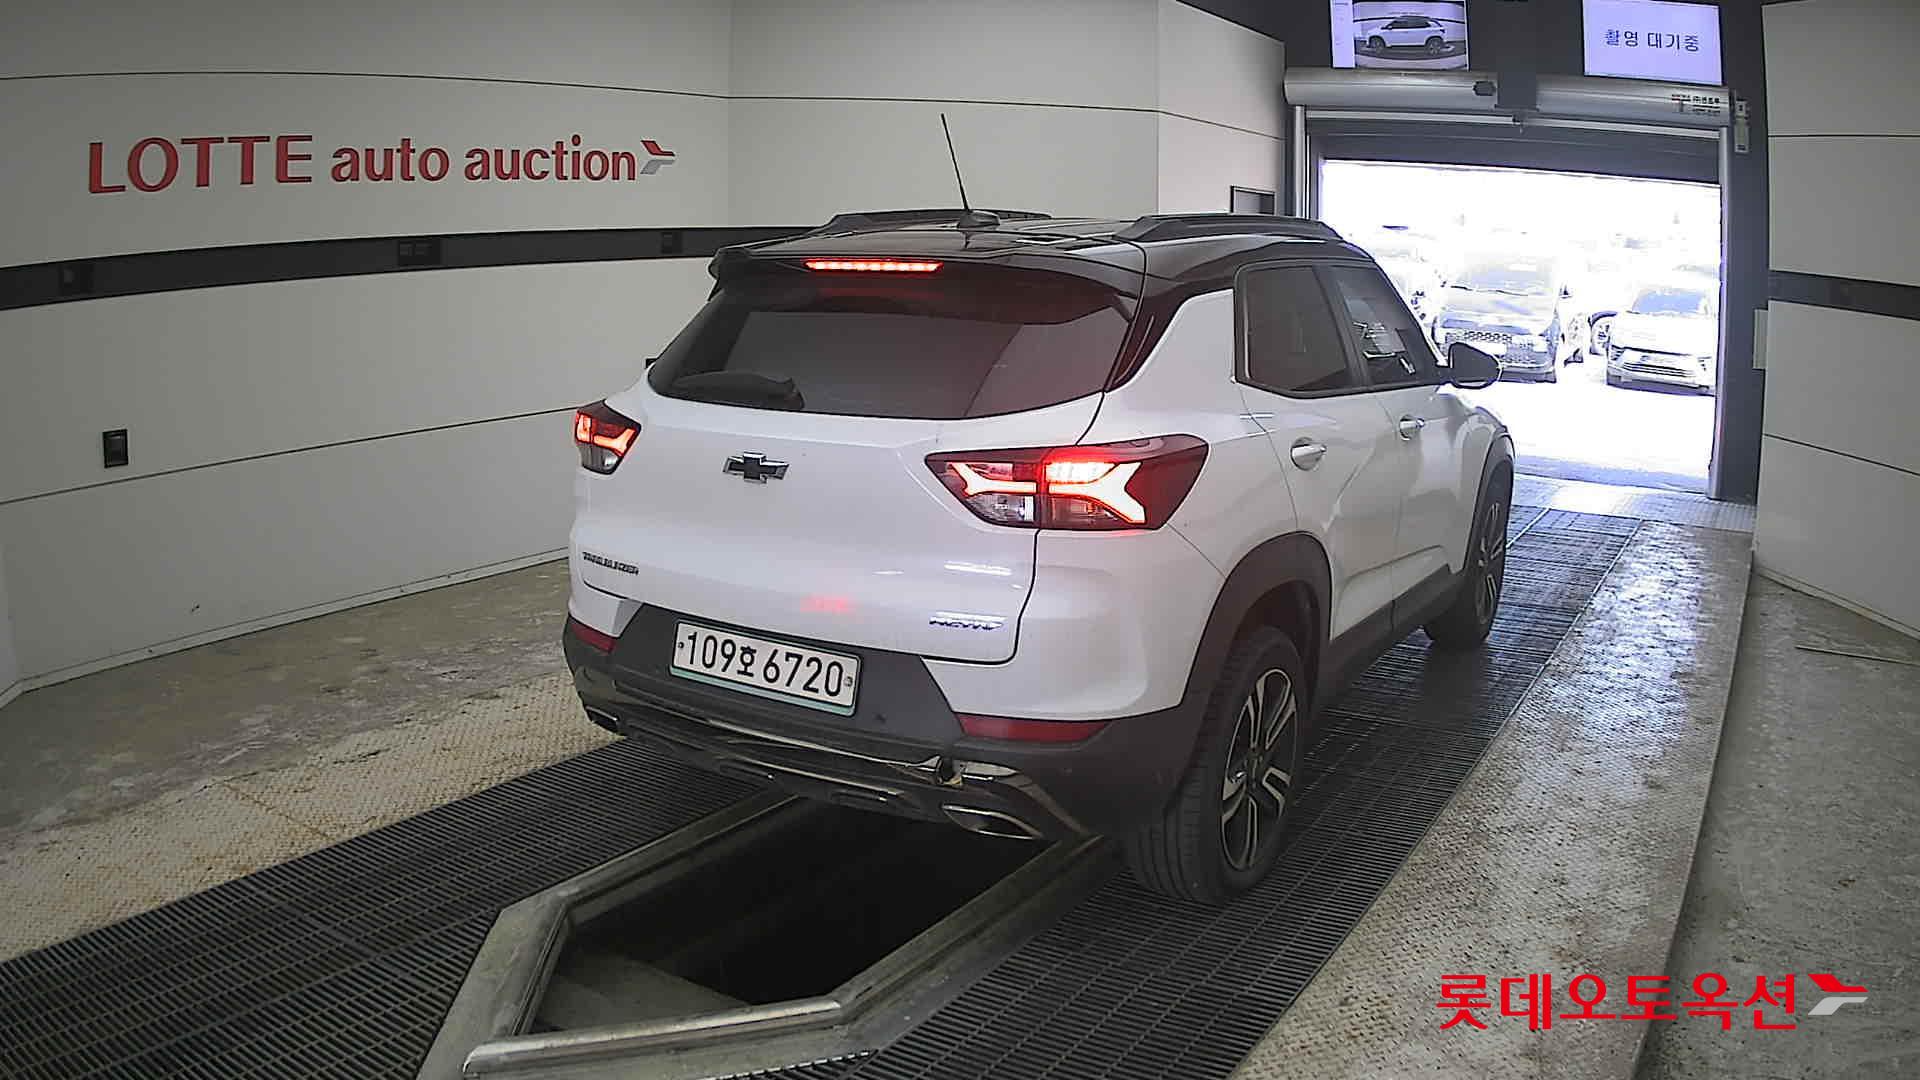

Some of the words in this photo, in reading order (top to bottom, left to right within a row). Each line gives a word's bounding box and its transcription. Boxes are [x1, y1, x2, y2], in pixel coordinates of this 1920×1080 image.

[1646, 32, 1699, 52] 대기중
[88, 135, 312, 193] LOTTE
[331, 138, 449, 182] auto
[464, 134, 637, 182] auction
[687, 631, 757, 677] 109호
[763, 648, 844, 697] 6720
